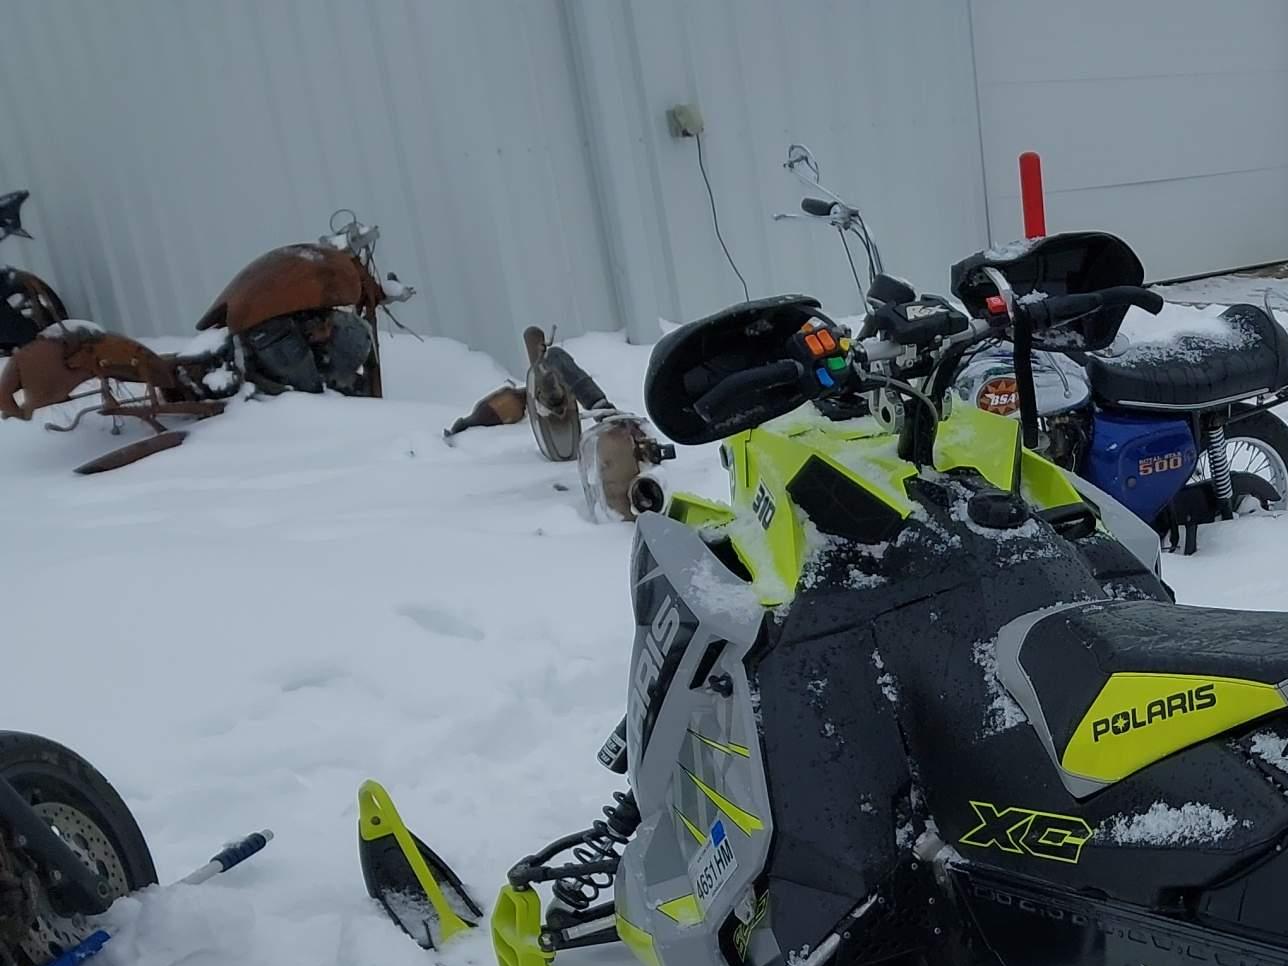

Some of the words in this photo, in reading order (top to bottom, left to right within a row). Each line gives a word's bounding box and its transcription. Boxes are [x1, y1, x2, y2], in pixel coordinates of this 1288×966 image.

[991, 393, 1019, 406] BSA
[1138, 456, 1183, 476] 500
[1092, 683, 1217, 743] POLARIS
[959, 800, 1093, 864] XC
